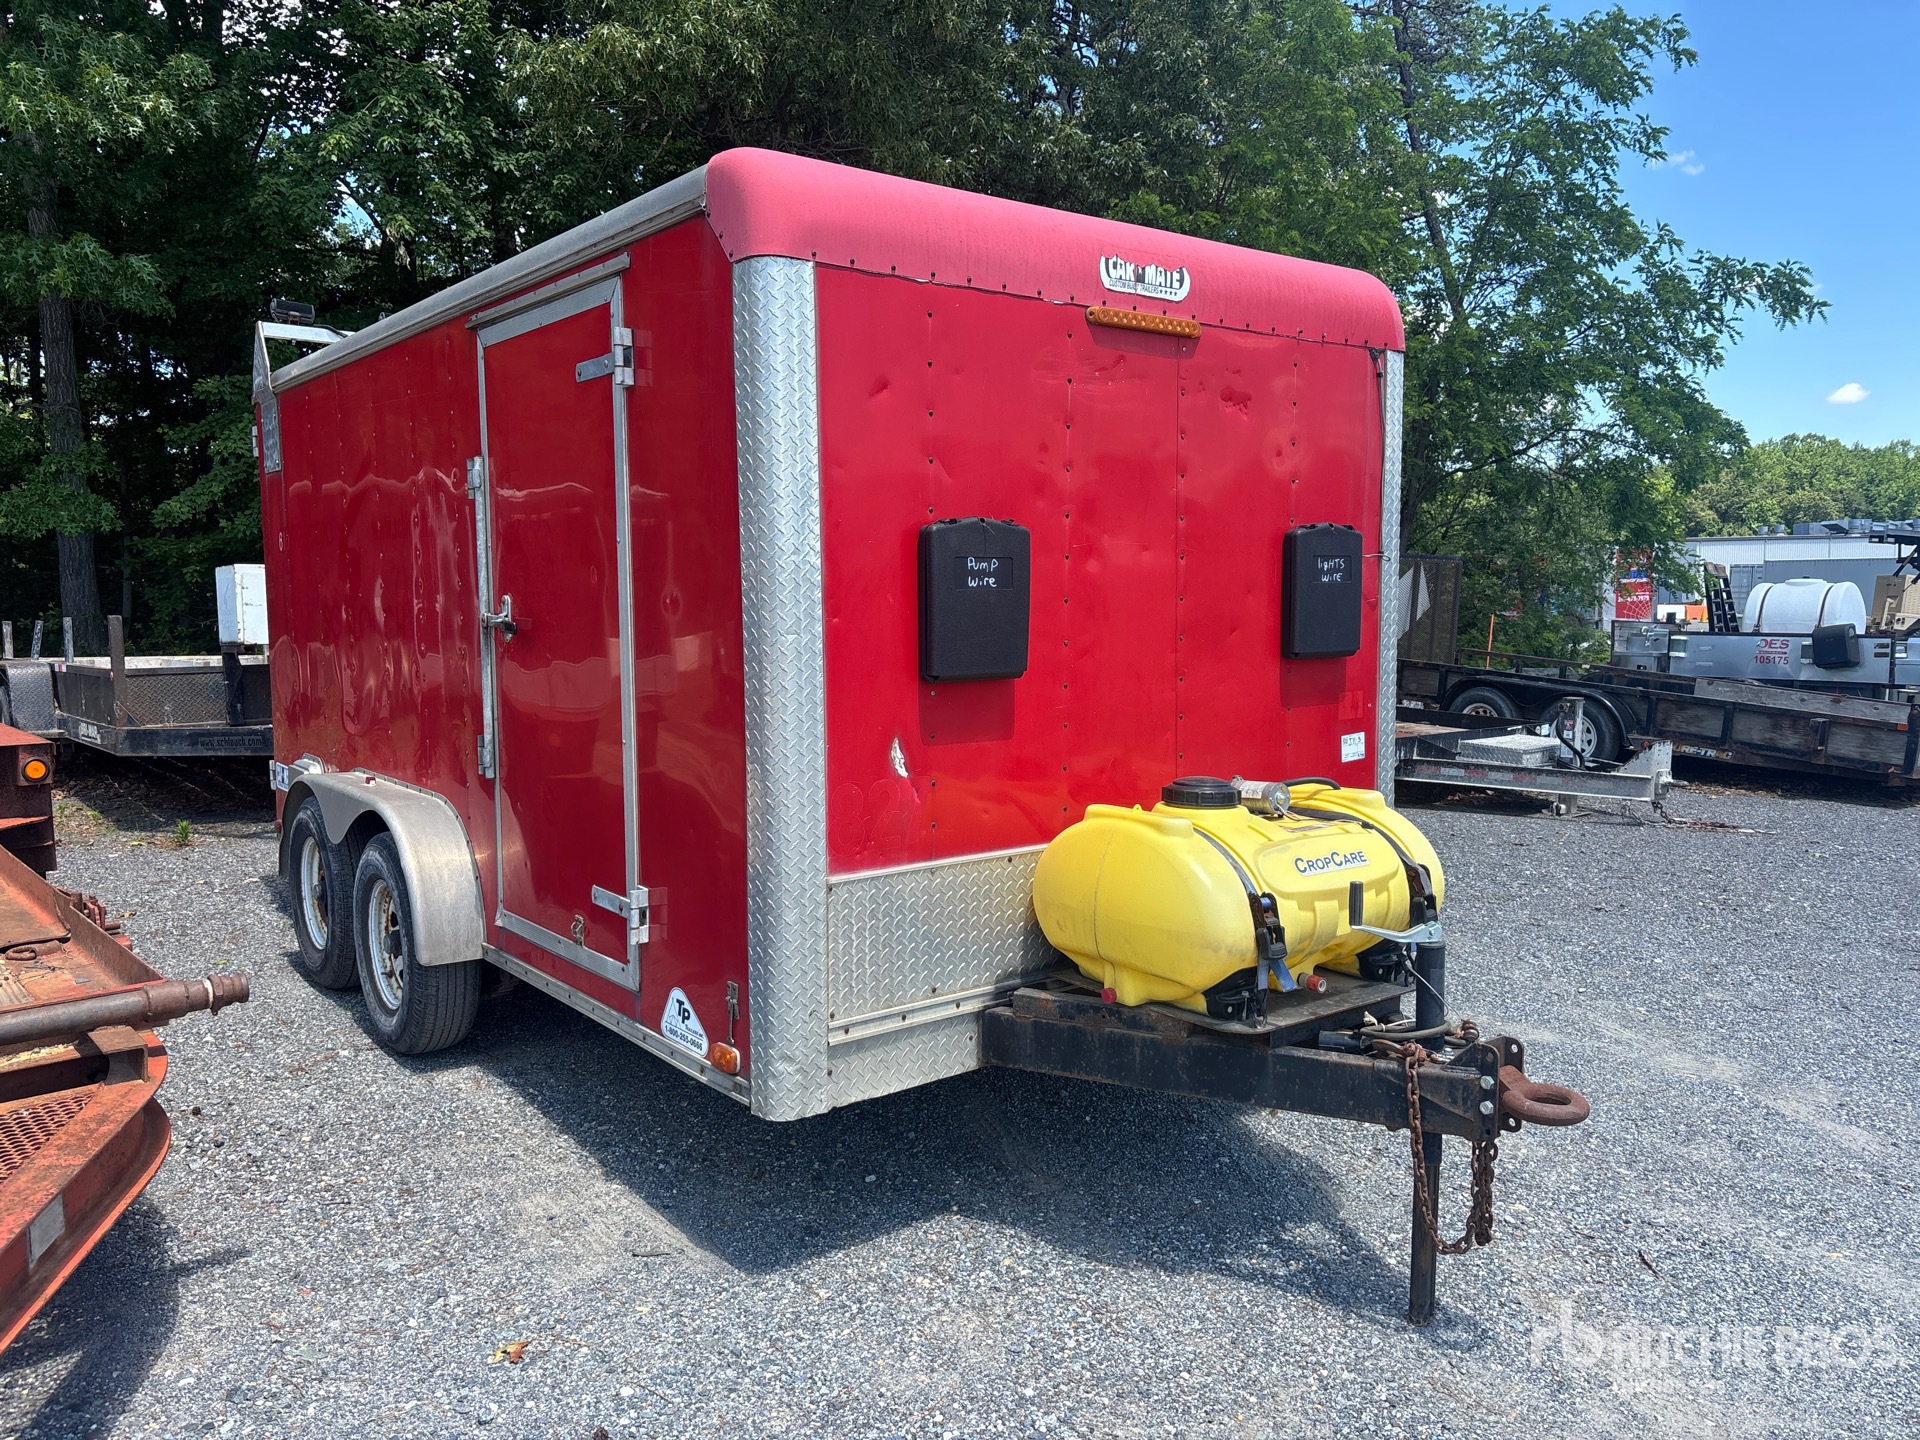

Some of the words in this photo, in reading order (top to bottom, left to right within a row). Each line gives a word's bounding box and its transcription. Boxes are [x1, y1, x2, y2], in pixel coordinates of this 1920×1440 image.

[1144, 263, 1182, 289] MATE
[1109, 279, 1127, 289] CUSTOM
[1140, 283, 1160, 294] TRAILERS
[1754, 655, 1789, 665] 105175
[676, 998, 691, 1025] TP
